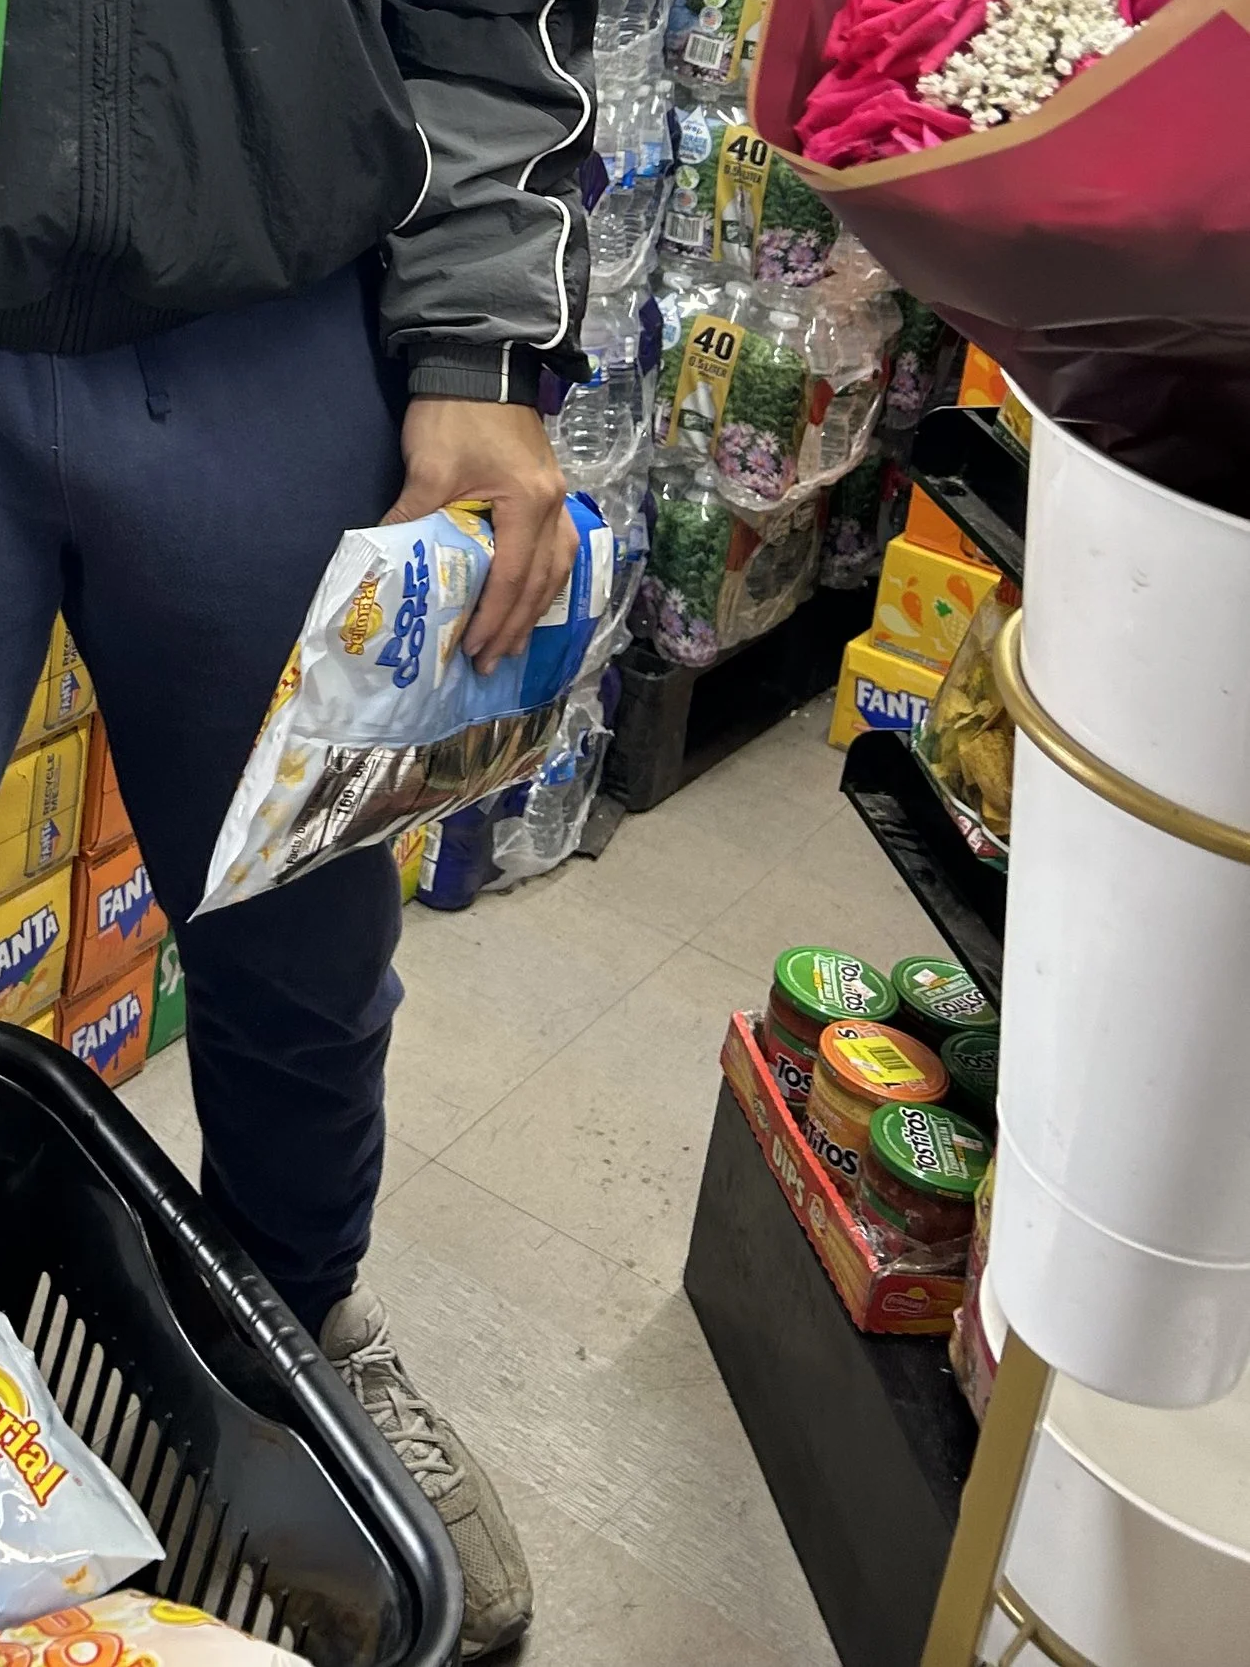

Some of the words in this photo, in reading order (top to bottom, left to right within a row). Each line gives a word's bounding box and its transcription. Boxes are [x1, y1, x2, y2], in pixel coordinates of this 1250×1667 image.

[727, 135, 768, 167] 40
[693, 326, 735, 361] 40
[856, 678, 928, 723] FANT
[337, 789, 355, 816] 160
[99, 864, 152, 927] FANT
[71, 992, 142, 1059] FANTA
[771, 1134, 805, 1206] DIPS
